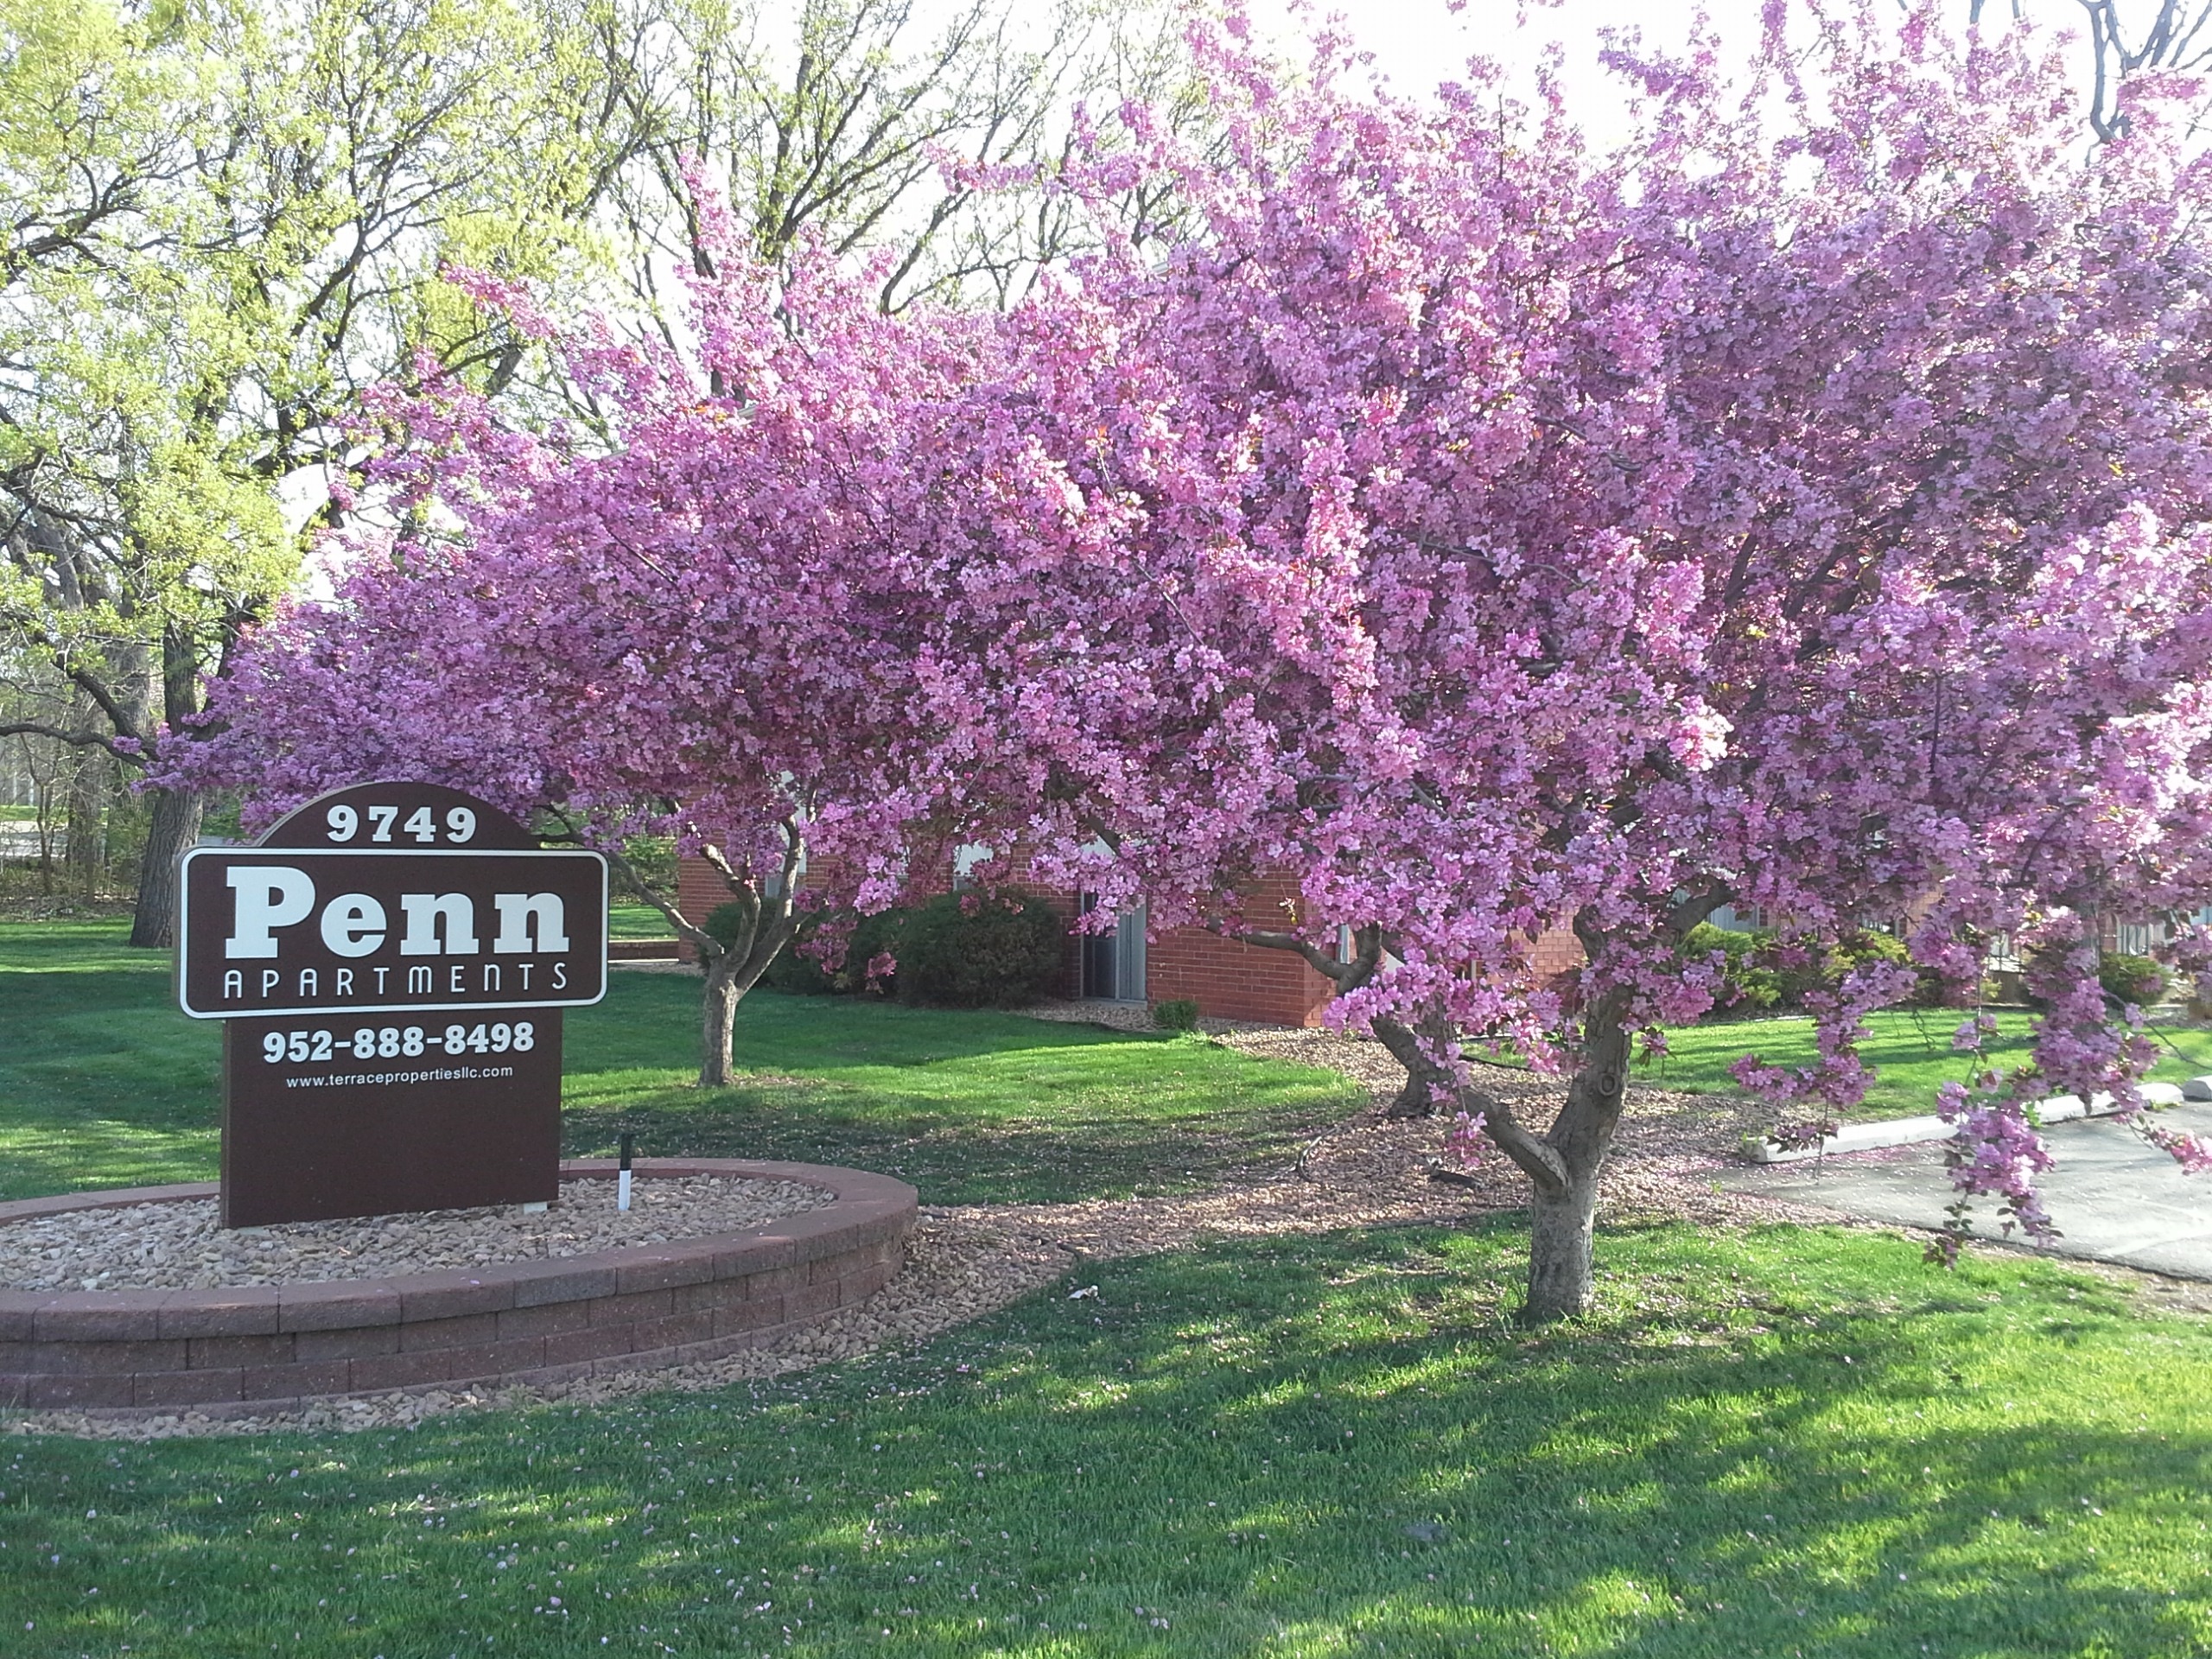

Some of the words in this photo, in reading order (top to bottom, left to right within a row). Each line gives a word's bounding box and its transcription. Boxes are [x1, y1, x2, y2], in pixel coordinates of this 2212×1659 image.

[327, 804, 477, 842] 9749
[226, 866, 570, 958] Penn
[224, 962, 567, 999] APARTMENTS
[263, 1021, 535, 1064] 952-888-8498
[286, 1065, 513, 1089] www.terracepropertiesllc.com
